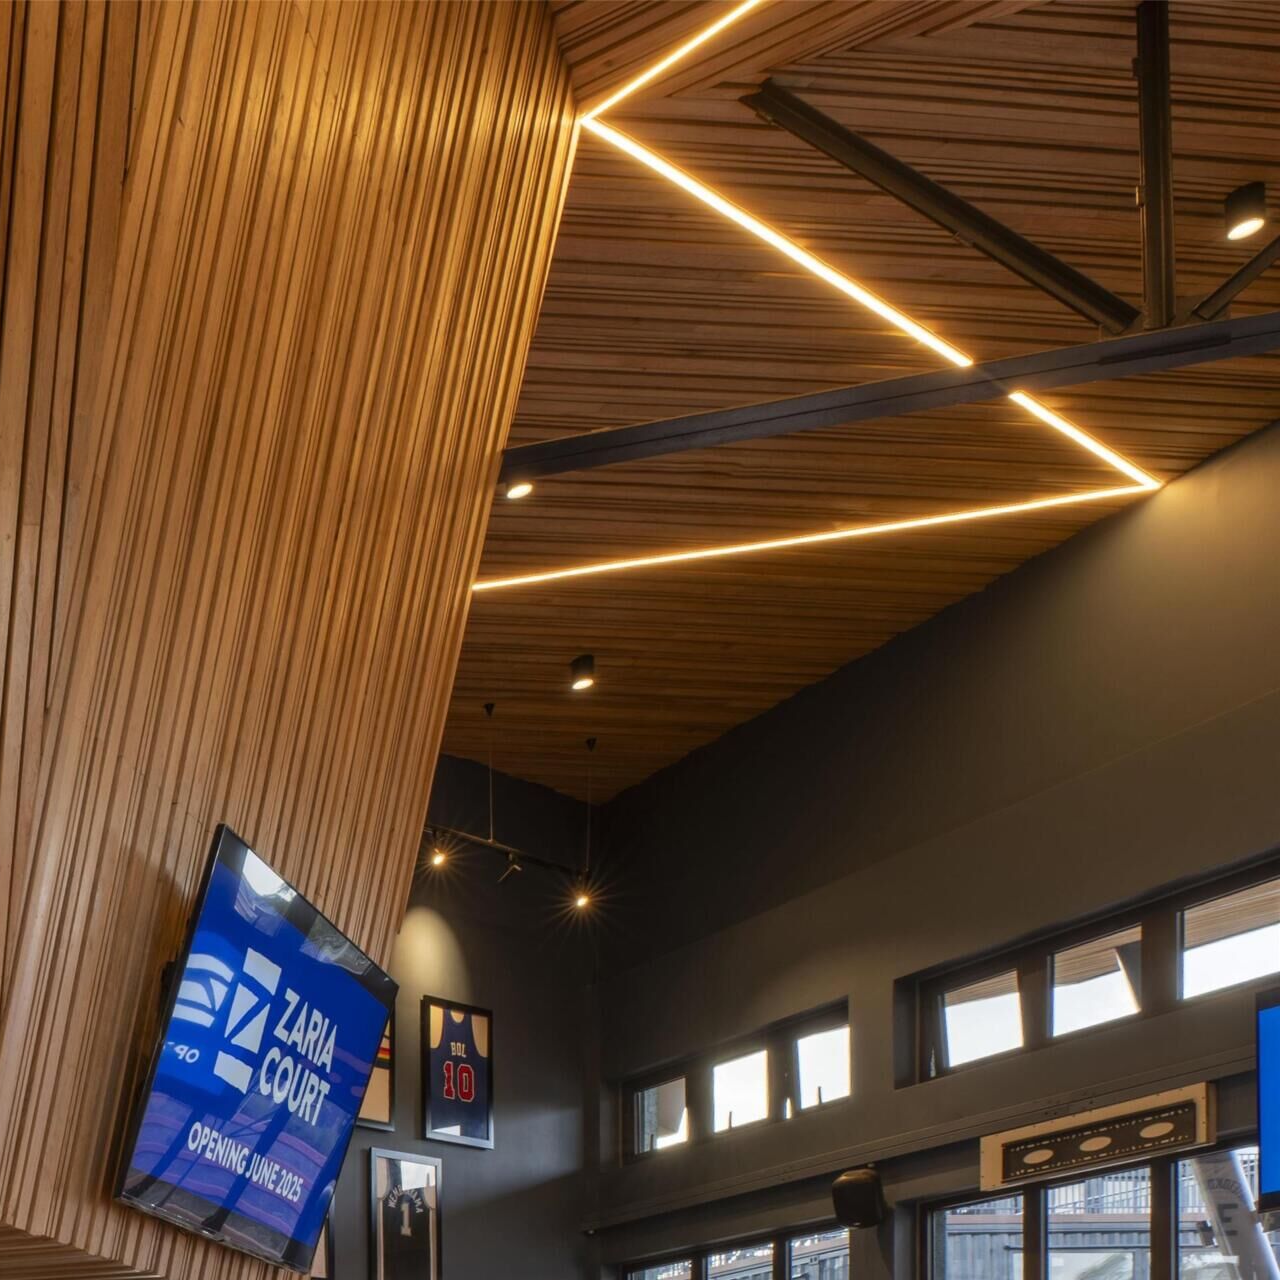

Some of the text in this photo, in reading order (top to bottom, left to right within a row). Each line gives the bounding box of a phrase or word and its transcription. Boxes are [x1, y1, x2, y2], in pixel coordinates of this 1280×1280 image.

[273, 987, 338, 1074] ZARIA
[450, 1041, 467, 1058] BOL
[259, 1046, 331, 1126] COURT
[443, 1060, 475, 1102] 10
[187, 1121, 304, 1202] OPENING JUNE 2025
[400, 1202, 412, 1237] 1
